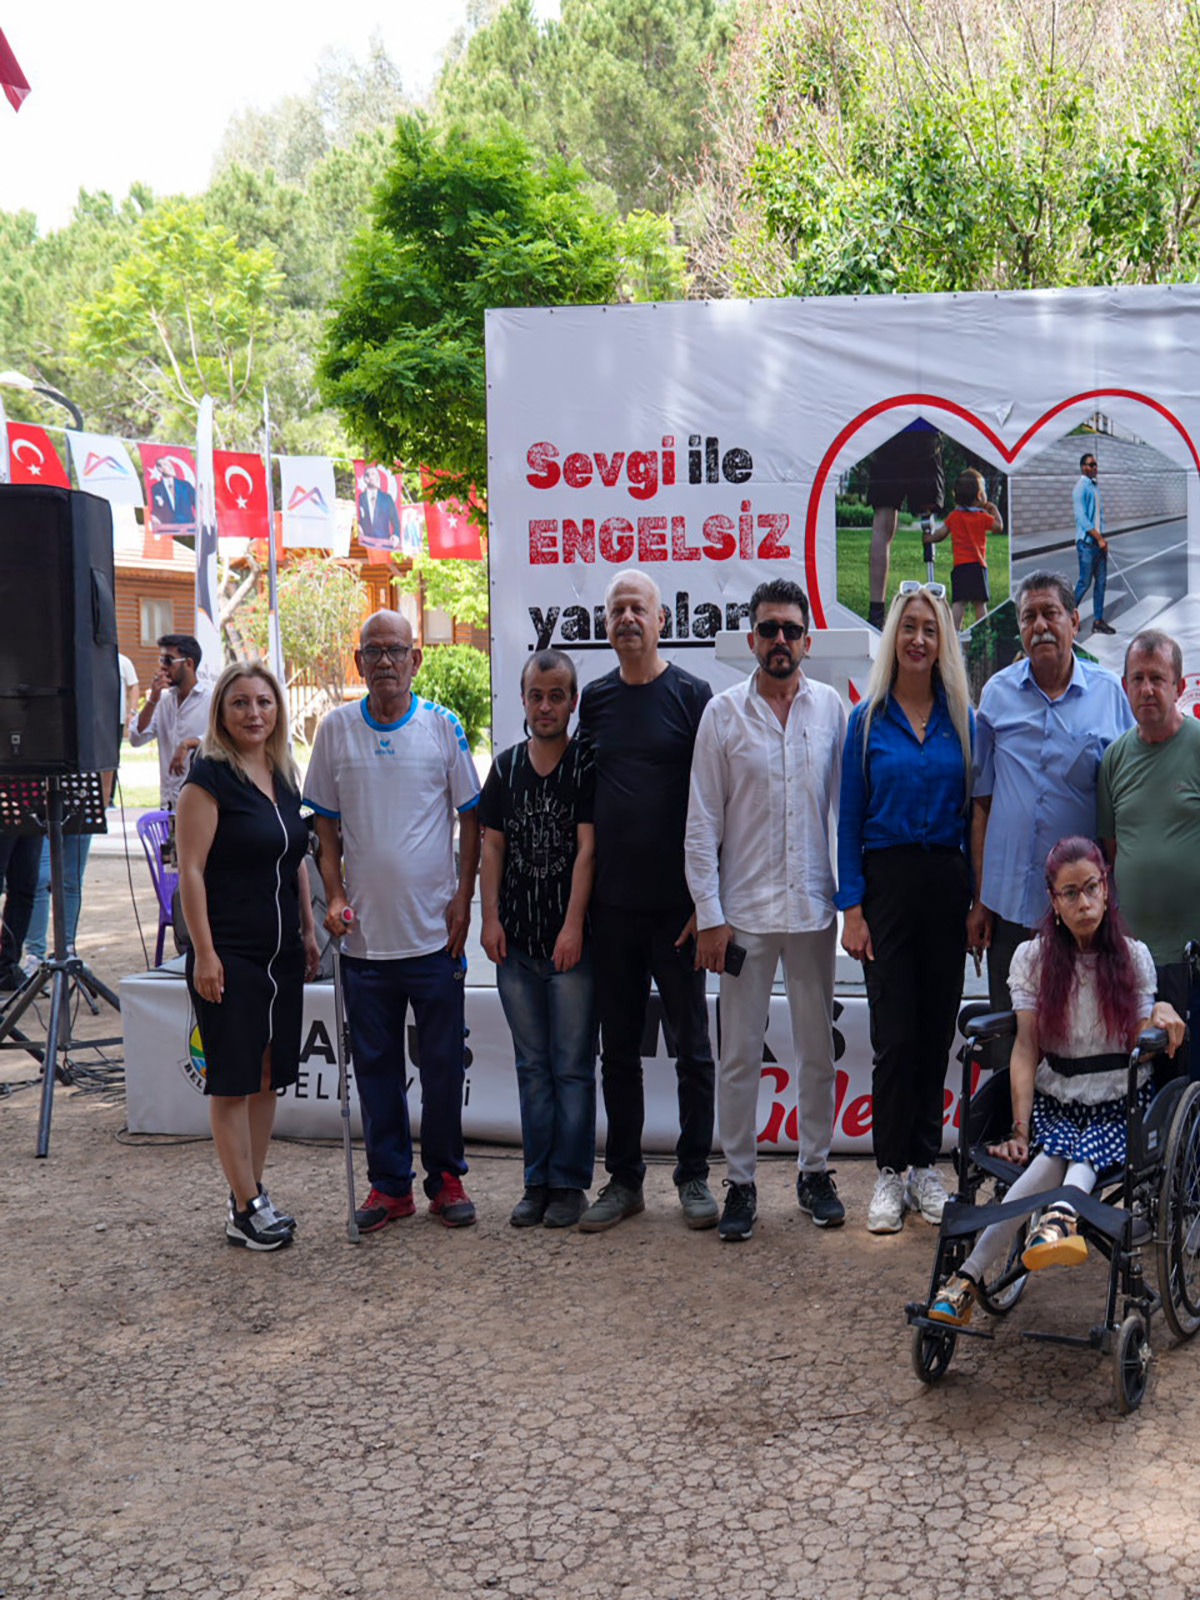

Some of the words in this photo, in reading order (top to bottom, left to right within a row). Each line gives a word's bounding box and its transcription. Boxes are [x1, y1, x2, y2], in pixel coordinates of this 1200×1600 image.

[526, 435, 675, 500] Sevgi
[688, 434, 754, 485] ile
[528, 500, 791, 564] ENGELSİZ
